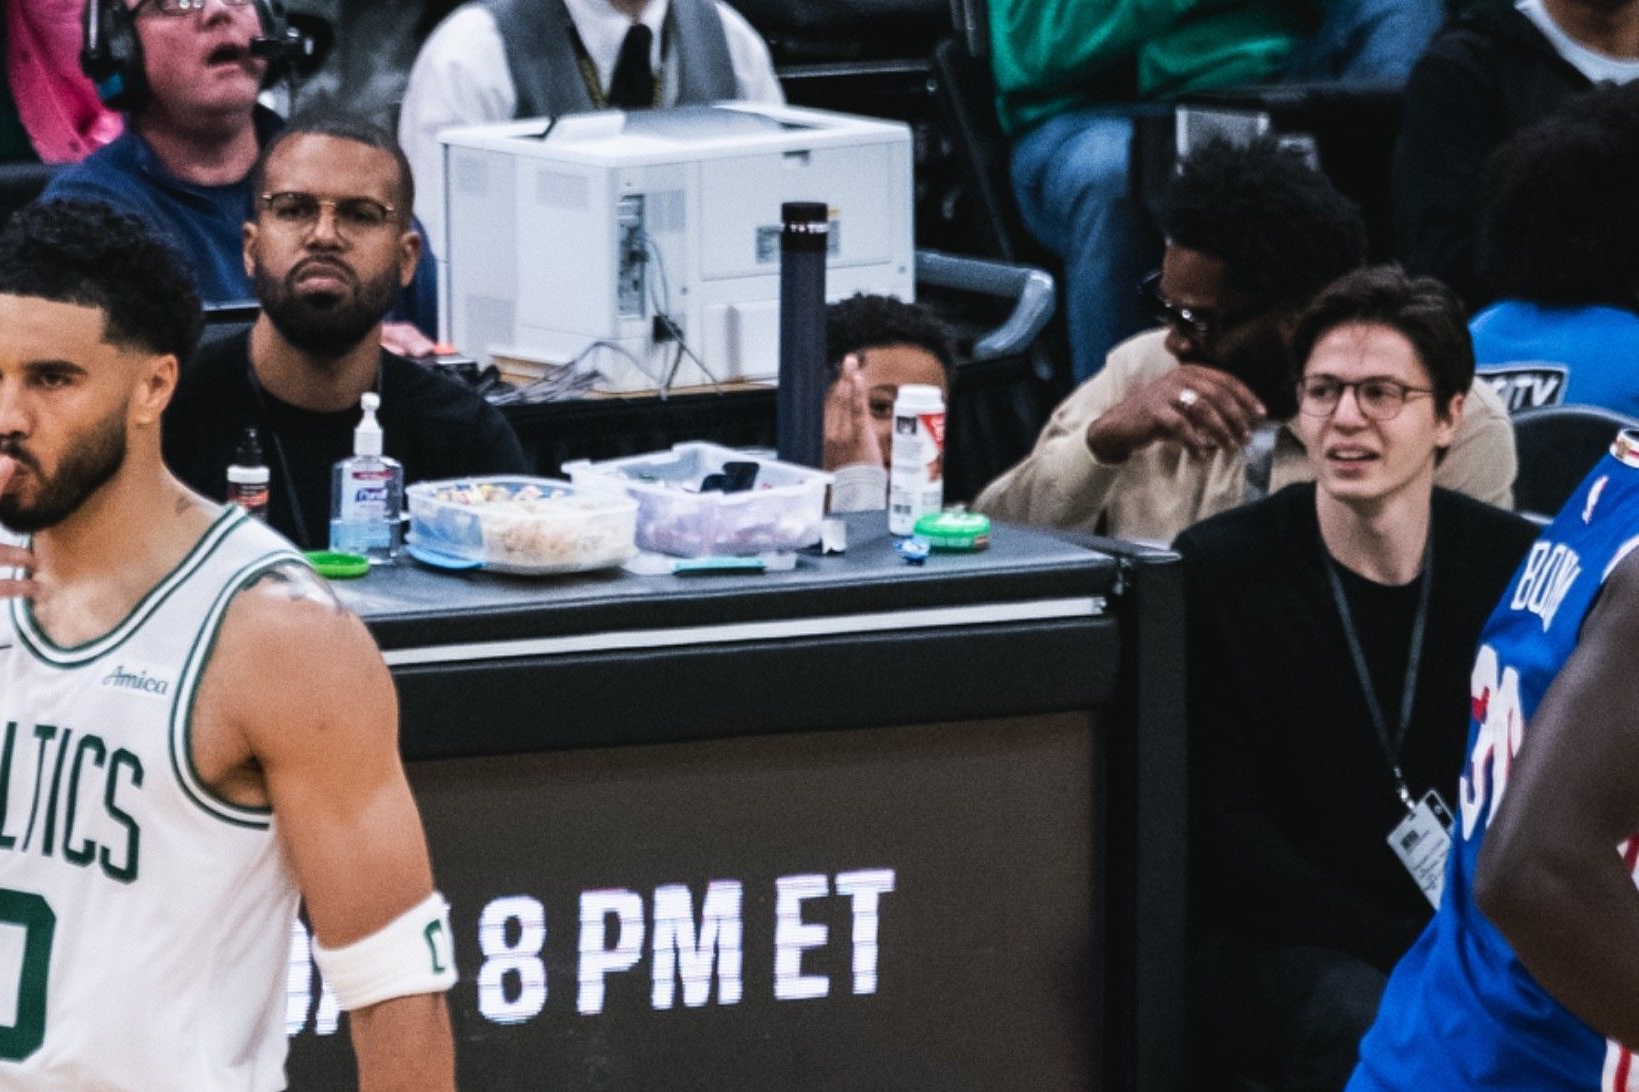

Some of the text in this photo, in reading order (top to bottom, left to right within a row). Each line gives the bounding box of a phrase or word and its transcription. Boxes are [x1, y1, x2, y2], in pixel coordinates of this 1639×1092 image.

[103, 665, 169, 695] Amica
[477, 894, 548, 1026] 8
[576, 878, 744, 1017] PM
[773, 867, 897, 1001] ET
